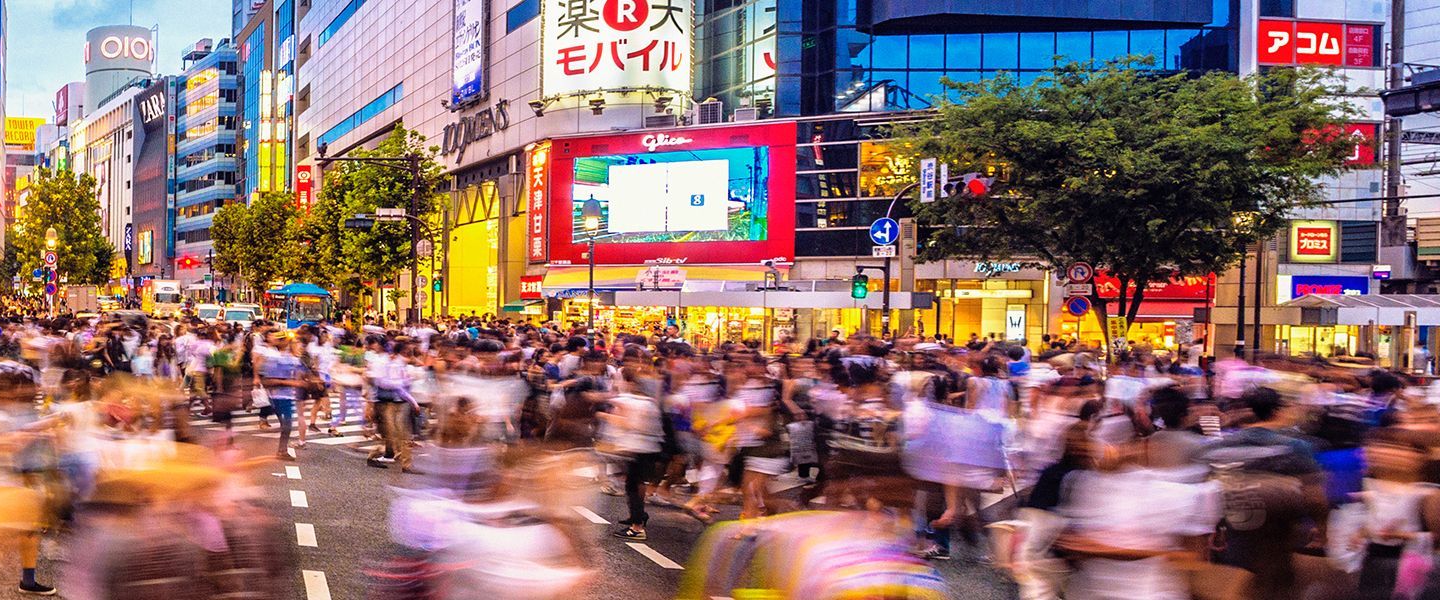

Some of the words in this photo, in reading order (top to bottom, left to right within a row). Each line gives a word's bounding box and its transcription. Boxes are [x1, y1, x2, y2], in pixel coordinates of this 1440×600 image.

[1268, 30, 1340, 55] アコム
[556, 39, 683, 76] モバイル
[8, 119, 35, 130] TOWER
[693, 195, 702, 206] 8
[532, 167, 544, 257] 天津甘栗
[1300, 238, 1328, 250] プロミス
